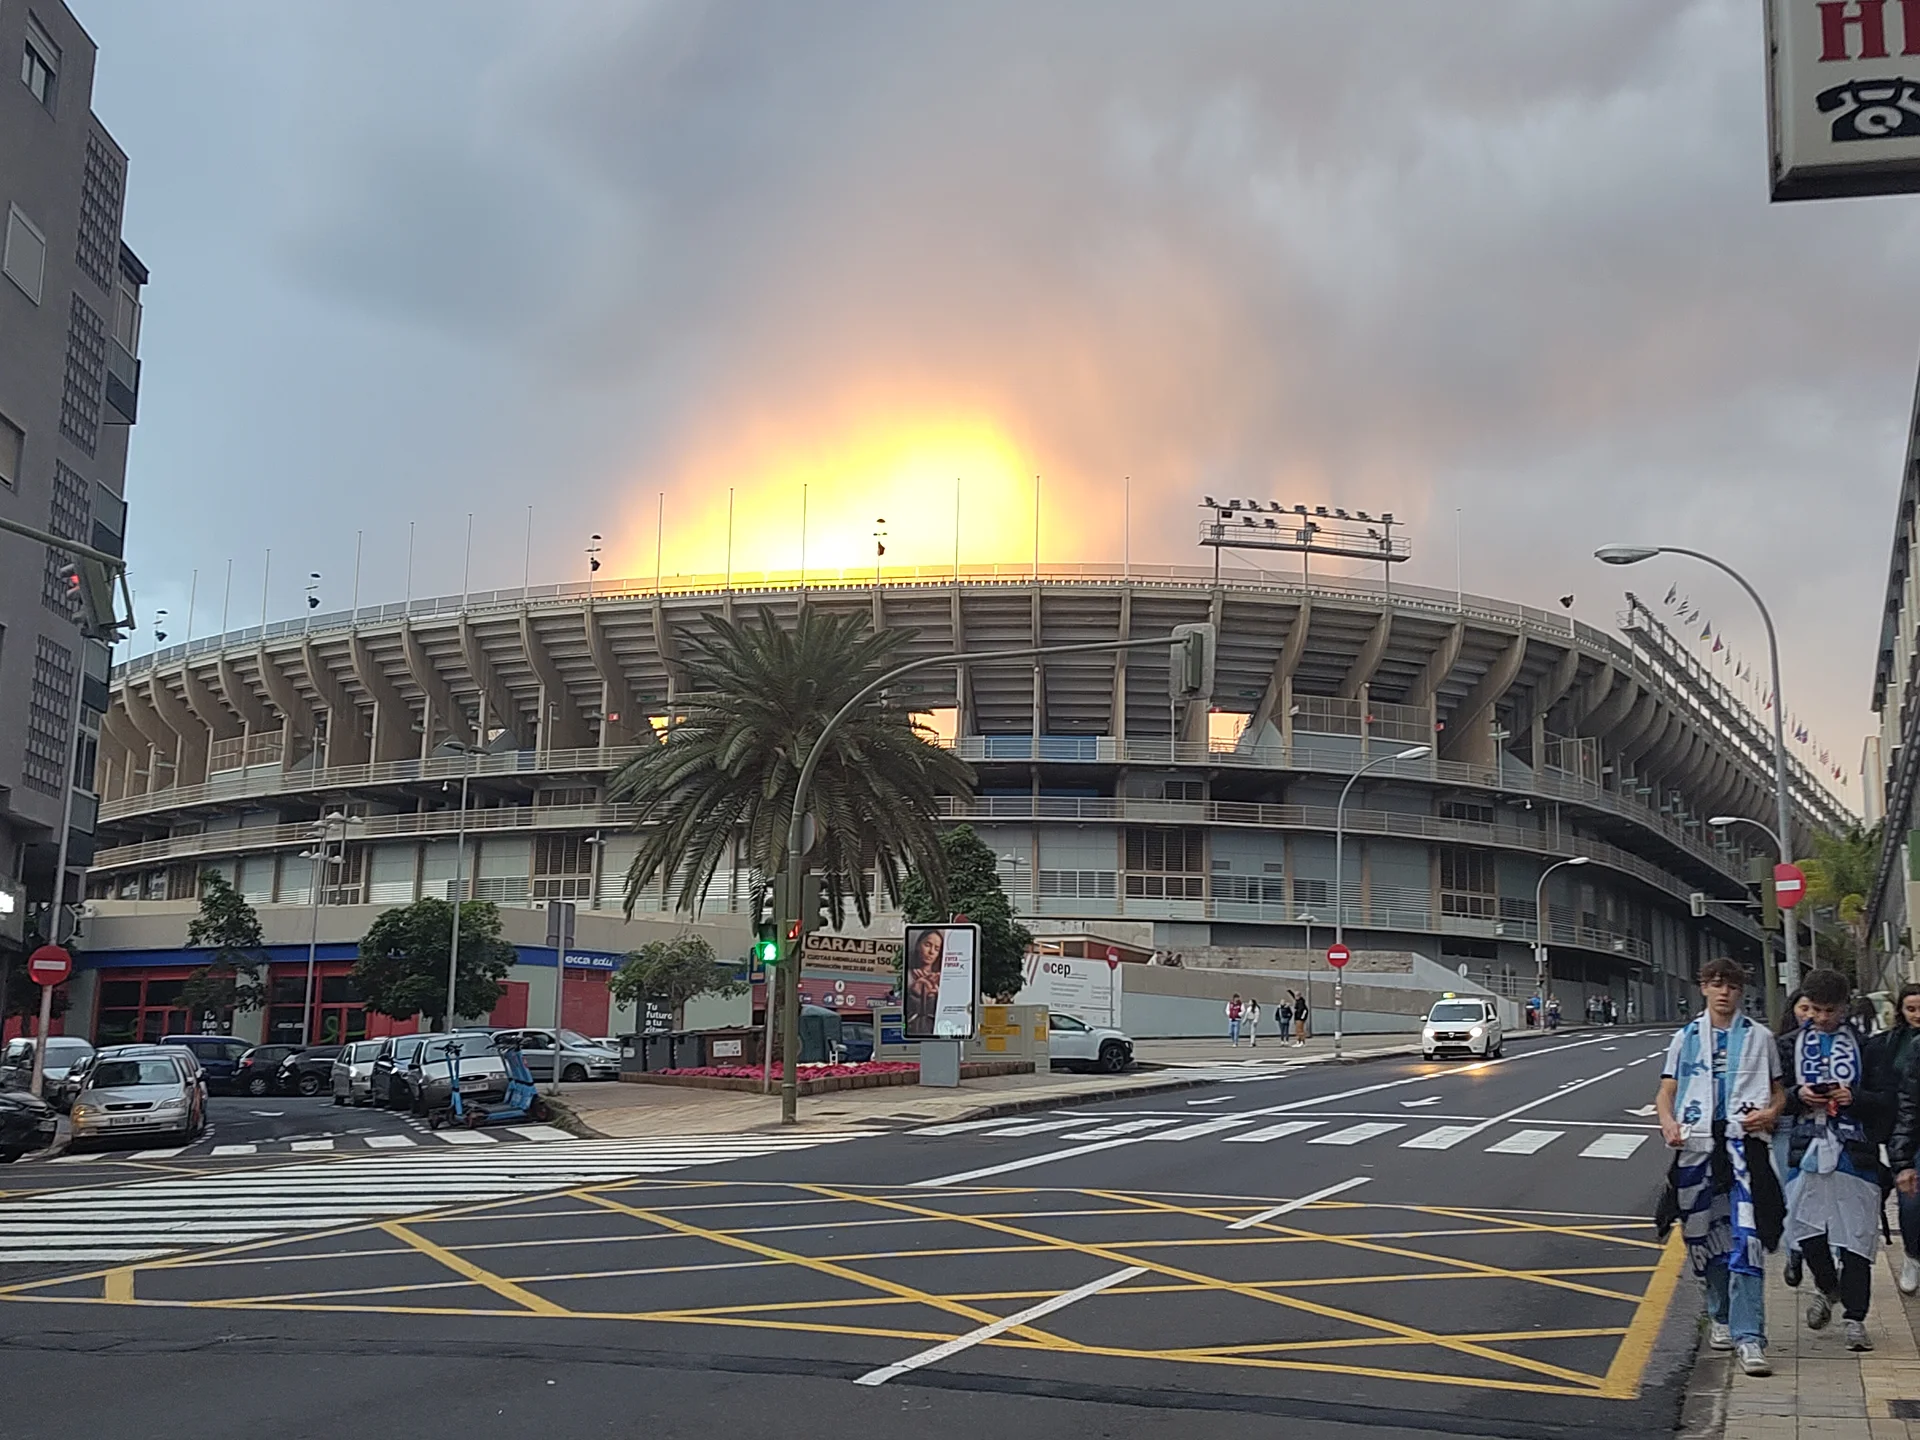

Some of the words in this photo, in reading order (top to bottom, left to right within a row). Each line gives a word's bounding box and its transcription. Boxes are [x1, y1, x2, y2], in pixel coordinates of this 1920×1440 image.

[806, 937, 875, 953] GARAJE
[877, 943, 902, 954] AQU
[832, 956, 867, 964] MENSUALES
[1050, 963, 1071, 978] cep
[646, 1002, 658, 1011] Tu
[645, 1011, 673, 1020] futuro
[652, 1019, 663, 1027] tu
[1803, 1030, 1821, 1075] RCD
